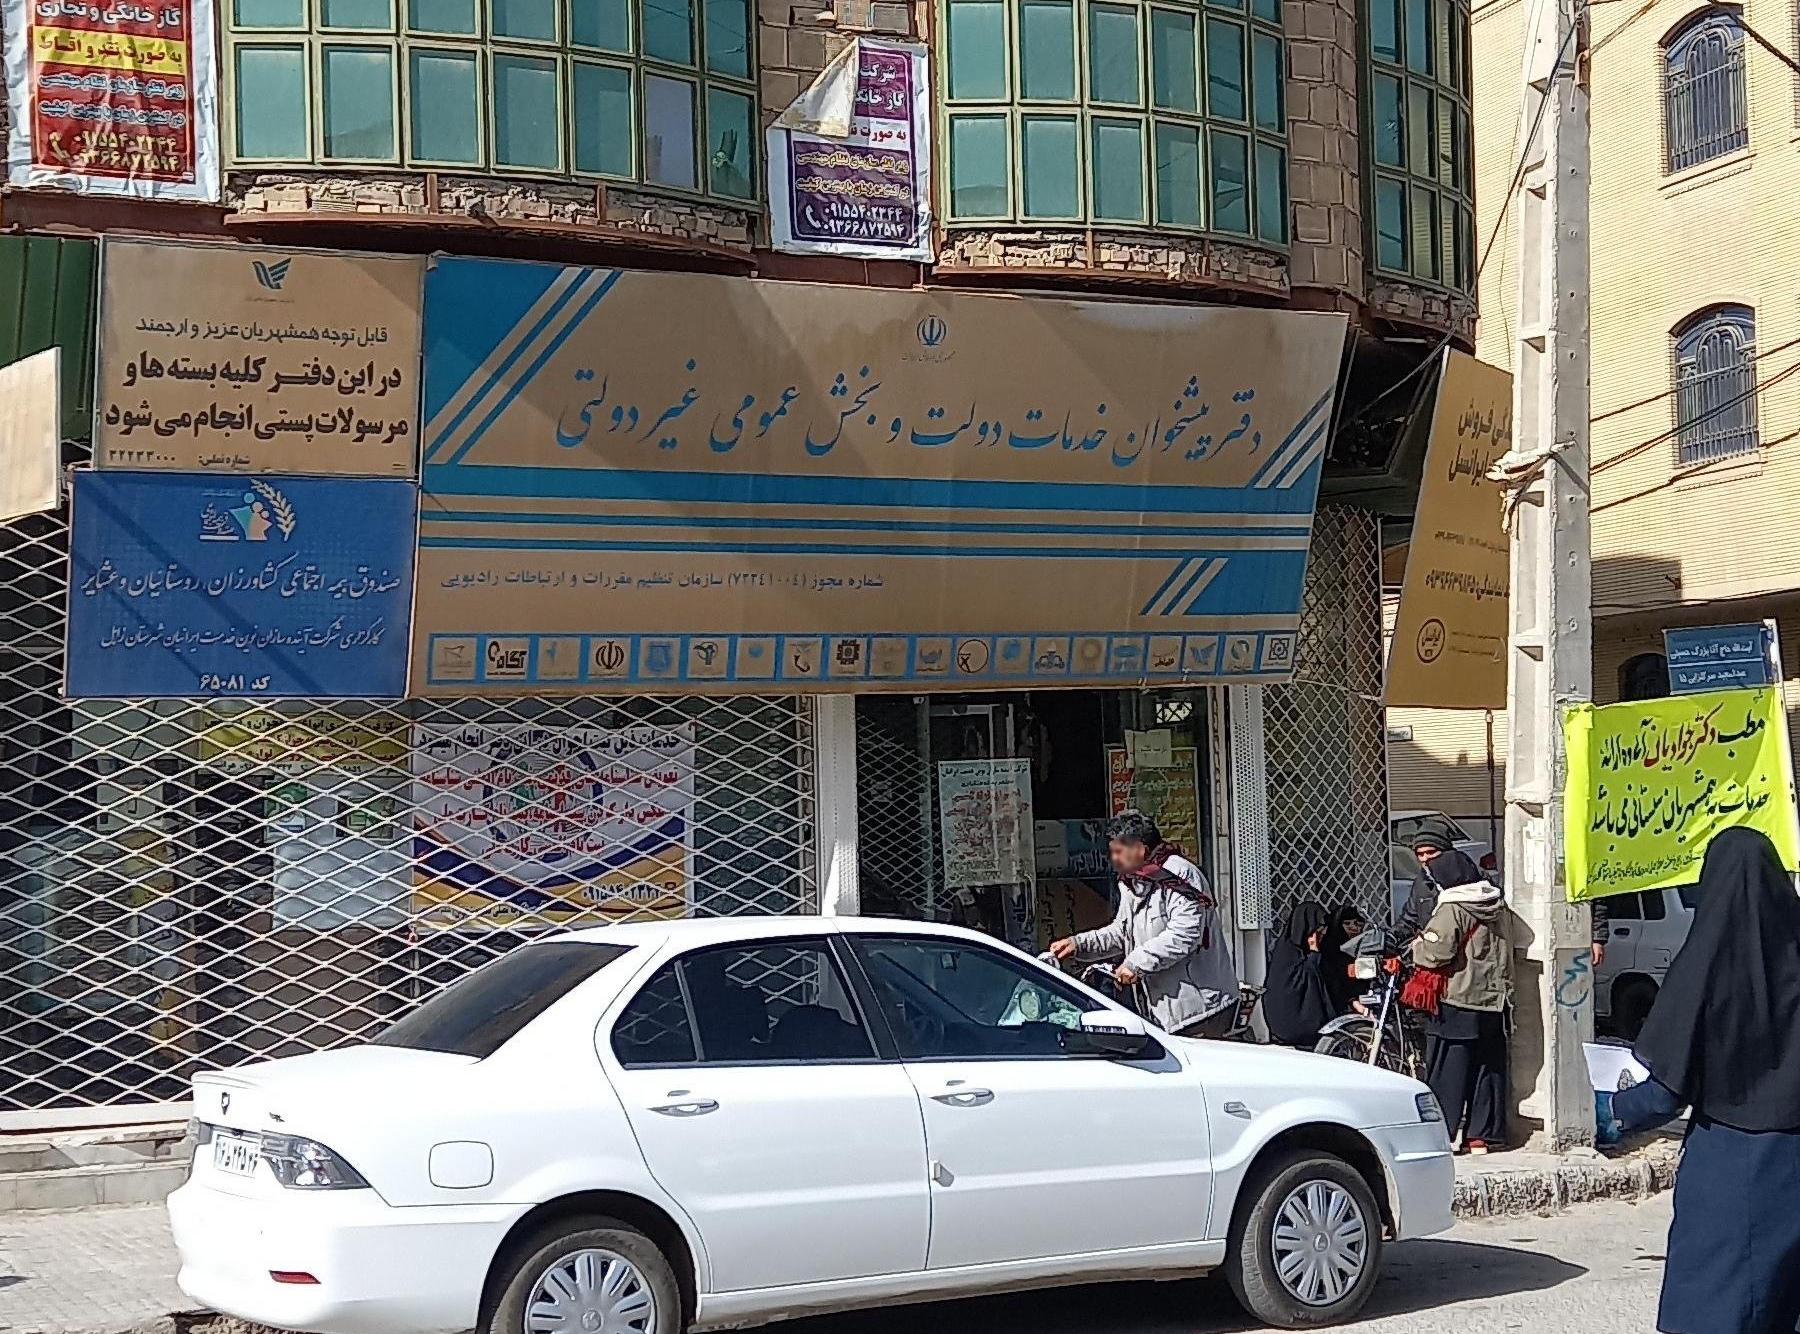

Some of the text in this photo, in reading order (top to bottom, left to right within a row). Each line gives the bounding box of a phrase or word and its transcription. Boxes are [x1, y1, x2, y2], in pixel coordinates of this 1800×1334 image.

[90, 6, 99, 21] و
[102, 1, 154, 24] خانگی
[157, 8, 180, 28] گاز
[40, 35, 182, 67] به صورت نقد و اقساط
[860, 63, 896, 83] شرکت
[886, 92, 905, 110] گاز
[861, 126, 893, 142] صورت
[897, 130, 906, 143] به
[135, 317, 388, 348] قابل توجه همشهریان عزیز و ارجمند
[122, 350, 402, 397] در این دفتر کلیه بسته ها و
[105, 400, 409, 444] مرسولات پستی انجام می شود
[556, 357, 1261, 467] دفتر پیشخوان خدمات دولت و بخش عمومی غیر دولتی
[1458, 397, 1494, 440] فروش
[81, 559, 118, 596] عشایر
[120, 578, 127, 590] و
[280, 566, 325, 597] اجتماعی
[328, 578, 347, 599] بیمه
[349, 566, 400, 598] صندوق
[440, 570, 499, 589] رادیویی
[504, 570, 564, 589] ارتباطات
[570, 574, 577, 588] و
[582, 571, 633, 589] مقررات
[637, 571, 673, 589] تنظیم
[678, 572, 723, 588] سازمان
[810, 576, 842, 592] مجوز
[848, 574, 883, 589] شماره
[101, 625, 126, 649] زابل
[124, 623, 164, 648] شهرستان
[163, 628, 200, 654] ایرانیان
[199, 628, 235, 644] خدمت
[235, 625, 258, 653] نوین
[309, 616, 345, 648] شرکت
[200, 674, 271, 691] کد ۶۵۰۸۱
[1684, 702, 1724, 765] دکتر
[1718, 708, 1766, 758] مطب
[1644, 721, 1696, 772] جوادیان
[1719, 774, 1770, 814] خدمات
